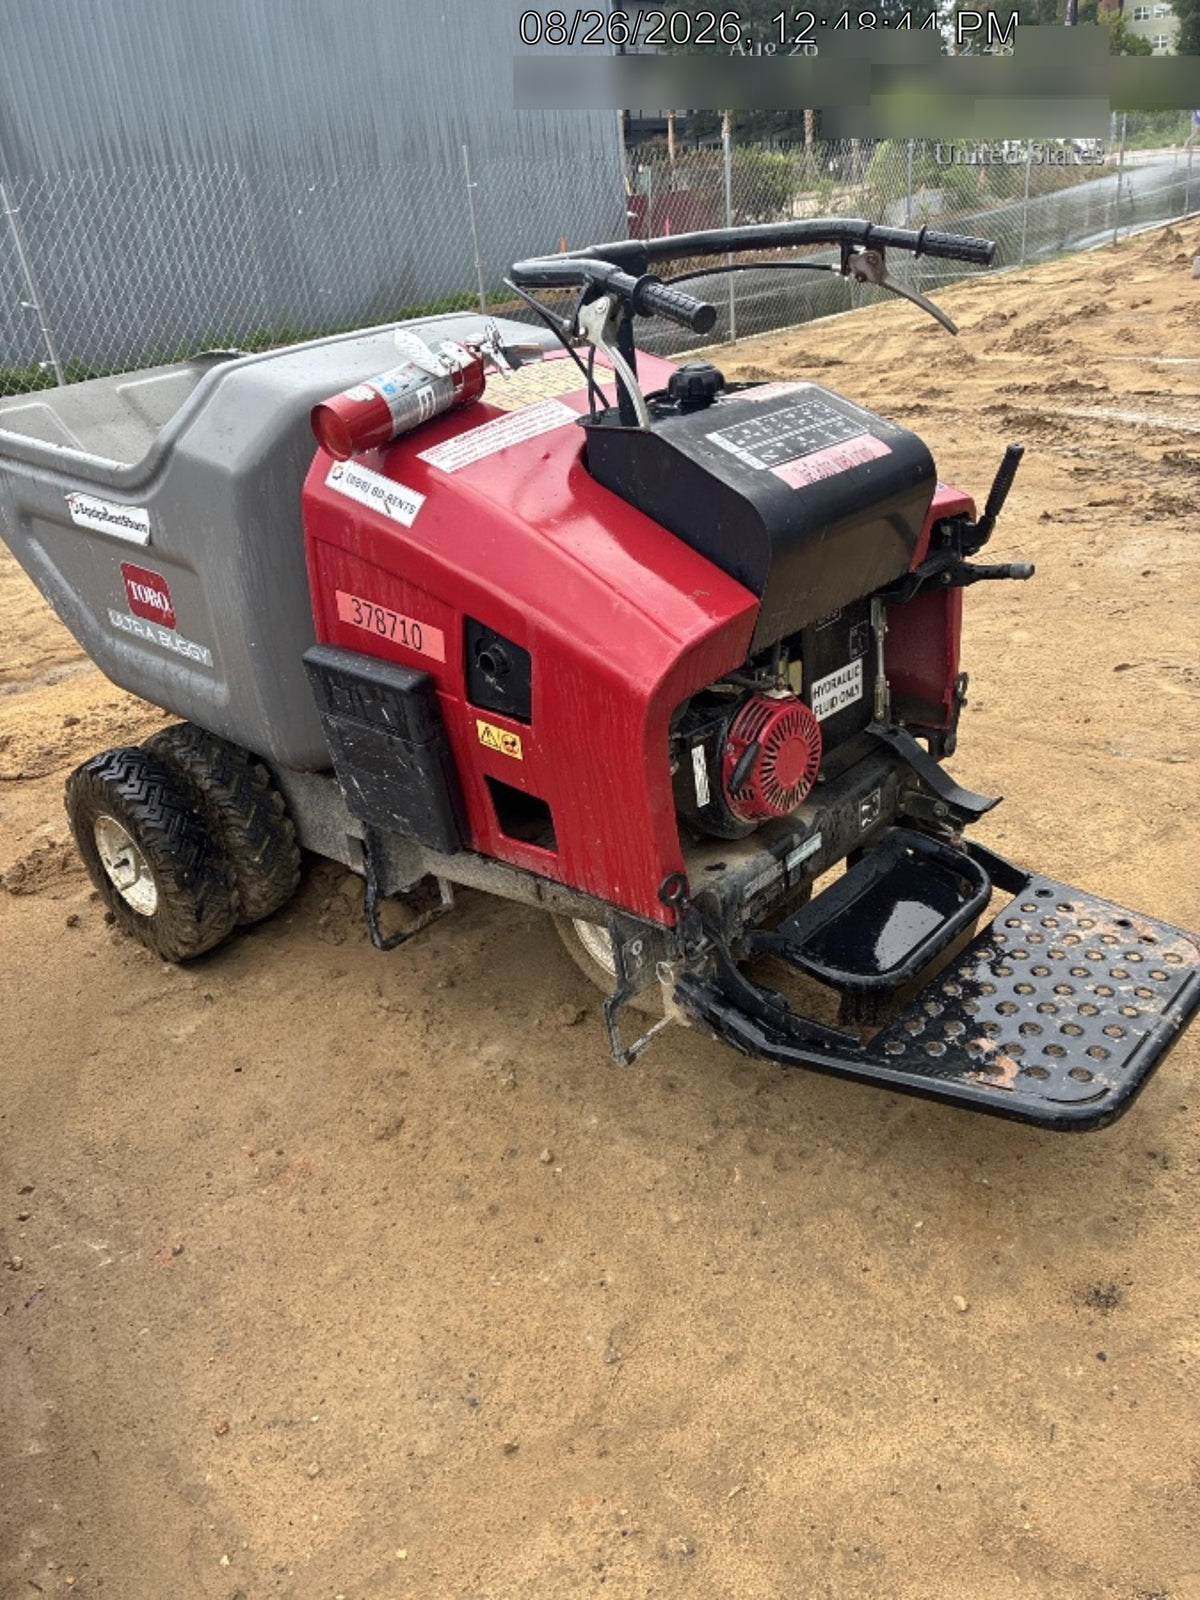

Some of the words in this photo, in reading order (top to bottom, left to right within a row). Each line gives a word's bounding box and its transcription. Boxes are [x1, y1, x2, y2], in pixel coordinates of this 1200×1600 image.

[127, 579, 172, 613] TORO
[108, 610, 157, 643] ULTRA
[157, 630, 207, 663] BUGGY
[351, 598, 422, 651] 378710
[813, 664, 860, 699] HYDRAULIC
[814, 696, 838, 716] FLUID
[839, 683, 860, 703] ONLY
